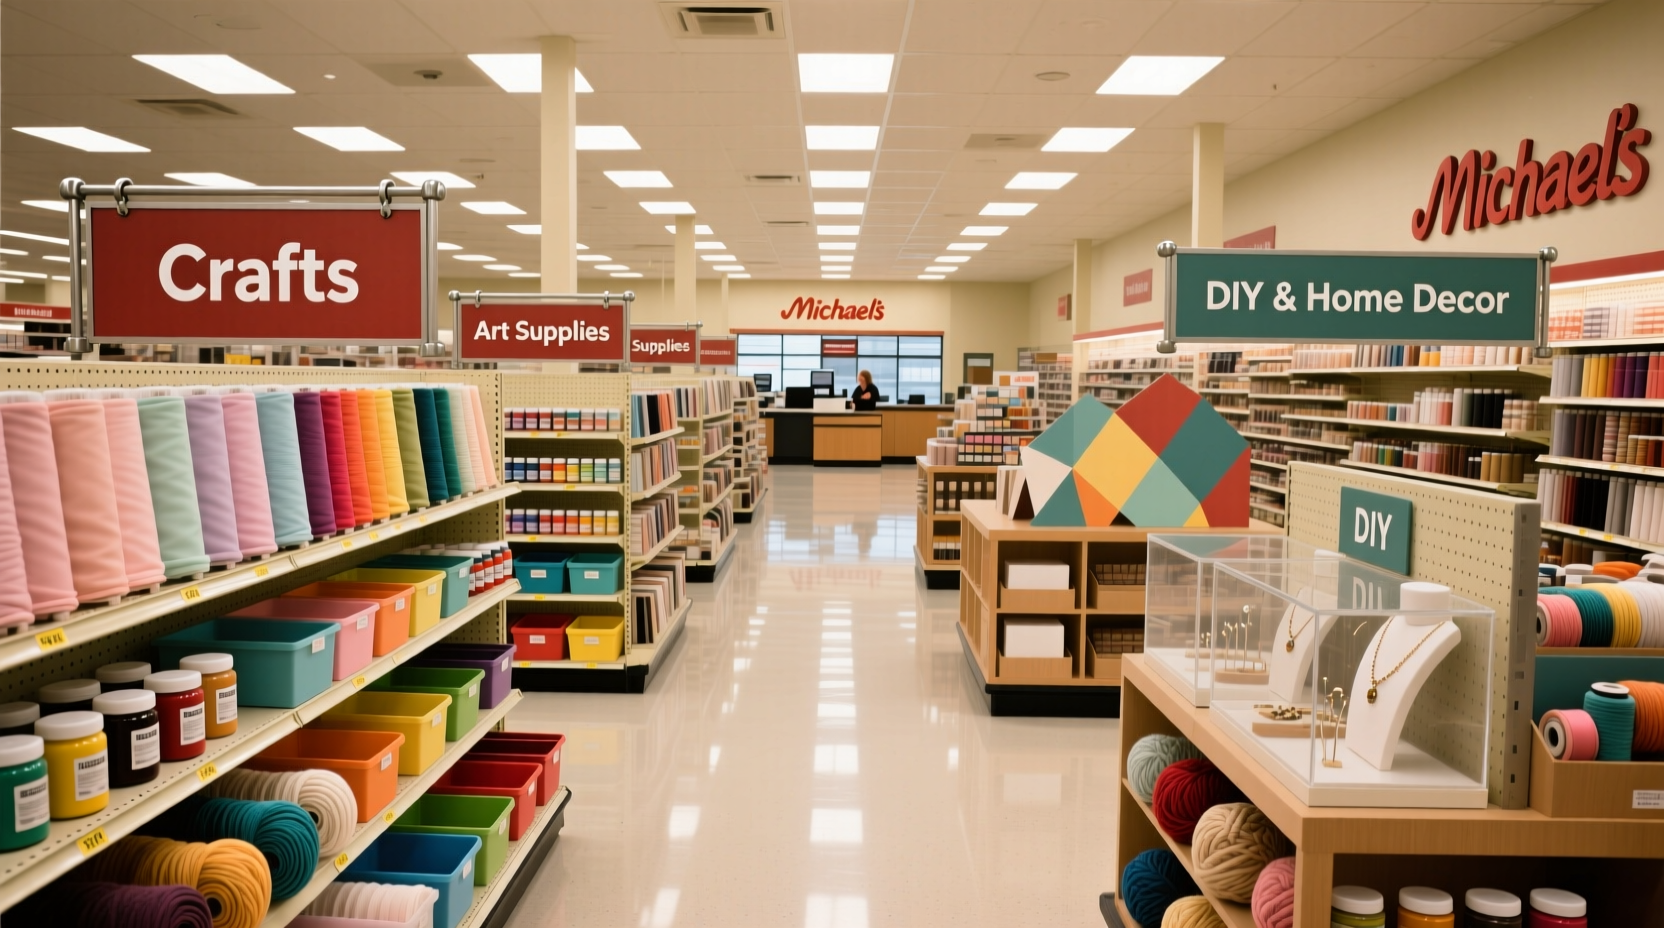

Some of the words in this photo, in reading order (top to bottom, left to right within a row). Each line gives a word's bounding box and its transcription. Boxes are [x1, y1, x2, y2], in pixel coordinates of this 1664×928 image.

[1411, 102, 1651, 240] Michael's
[158, 241, 359, 303] Crafts
[780, 295, 885, 322] Michael's
[1206, 280, 1264, 311] DIY
[1272, 281, 1297, 312] &
[1307, 282, 1404, 313] Home
[1413, 283, 1510, 314] Decor
[473, 319, 510, 341] Art
[515, 319, 610, 347] Supplies
[631, 338, 691, 356] Supplies
[1354, 505, 1393, 551] DIY
